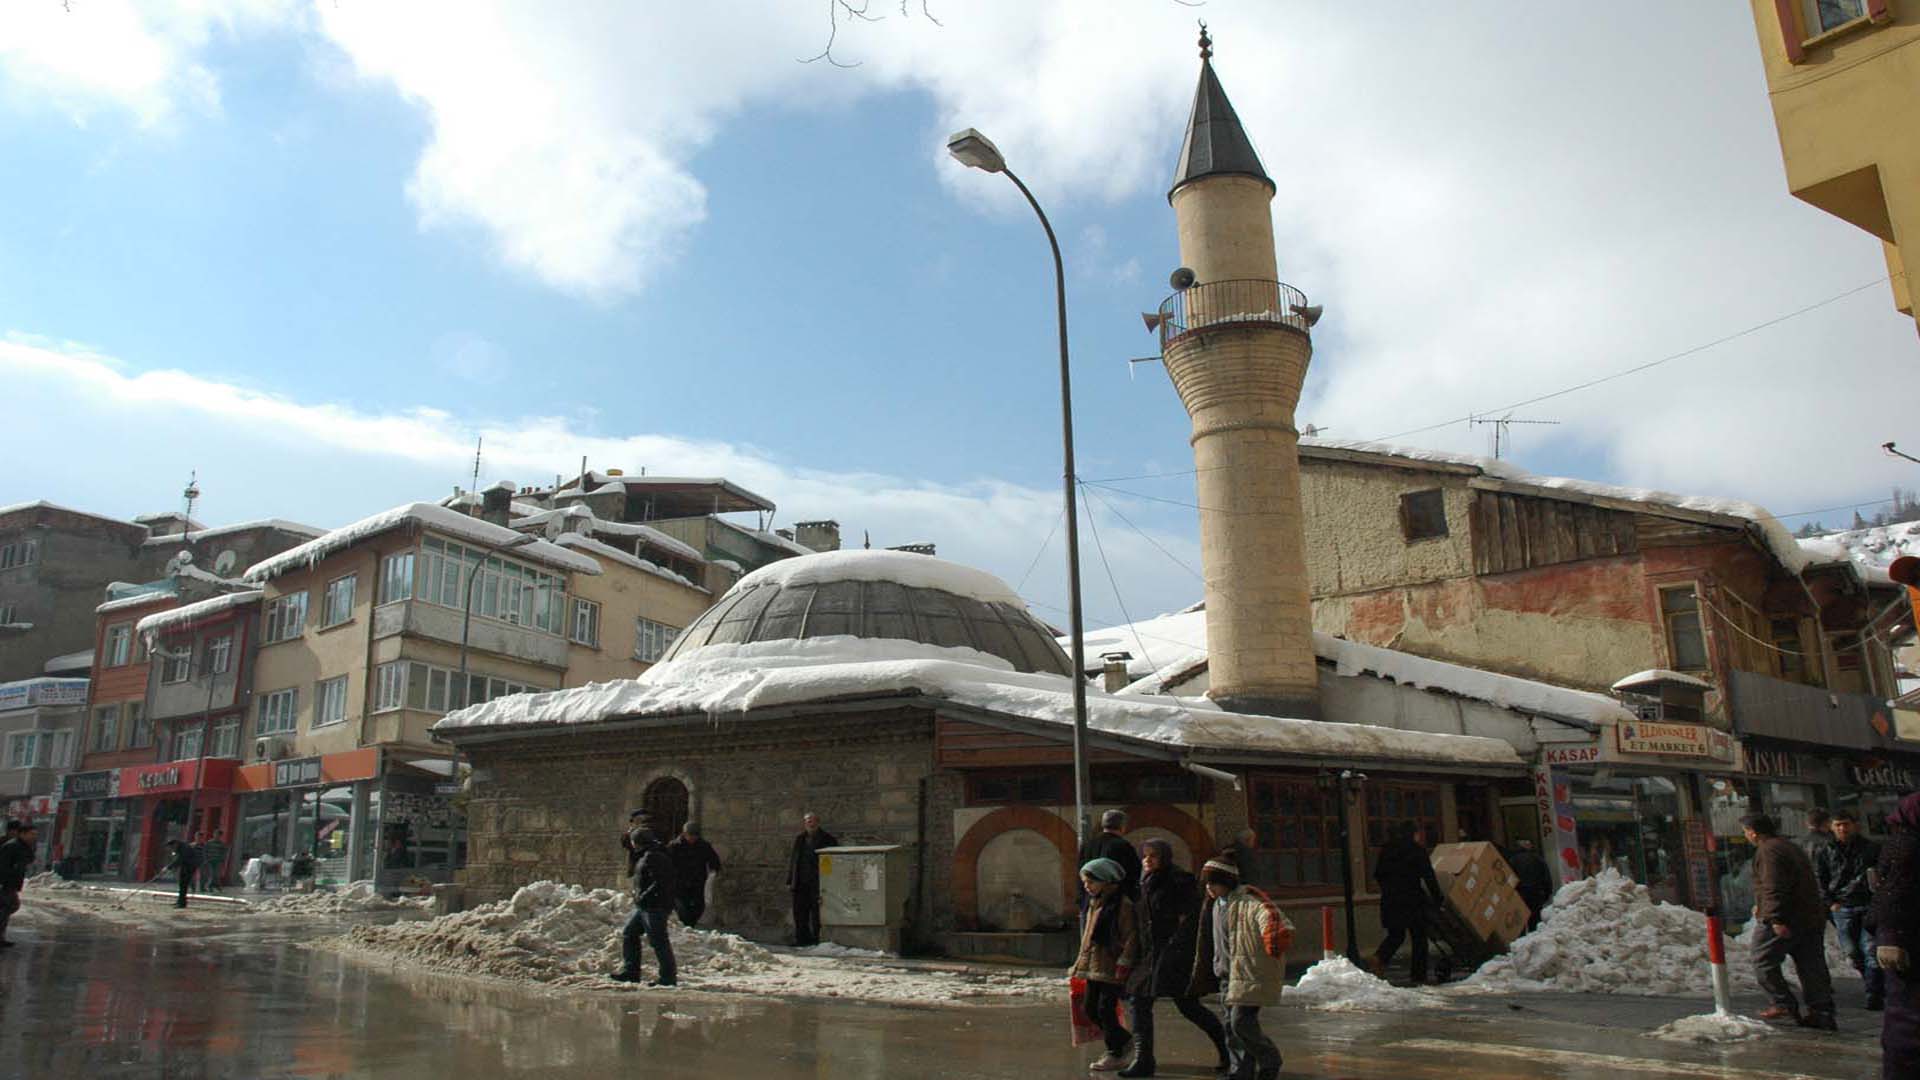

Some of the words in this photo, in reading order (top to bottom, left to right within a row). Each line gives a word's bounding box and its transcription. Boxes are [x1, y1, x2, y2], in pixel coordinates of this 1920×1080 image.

[1630, 741, 1646, 750] ET
[1648, 742, 1697, 753] MARKET
[1547, 748, 1598, 762] KASAP
[1536, 772, 1553, 837] KASAP
